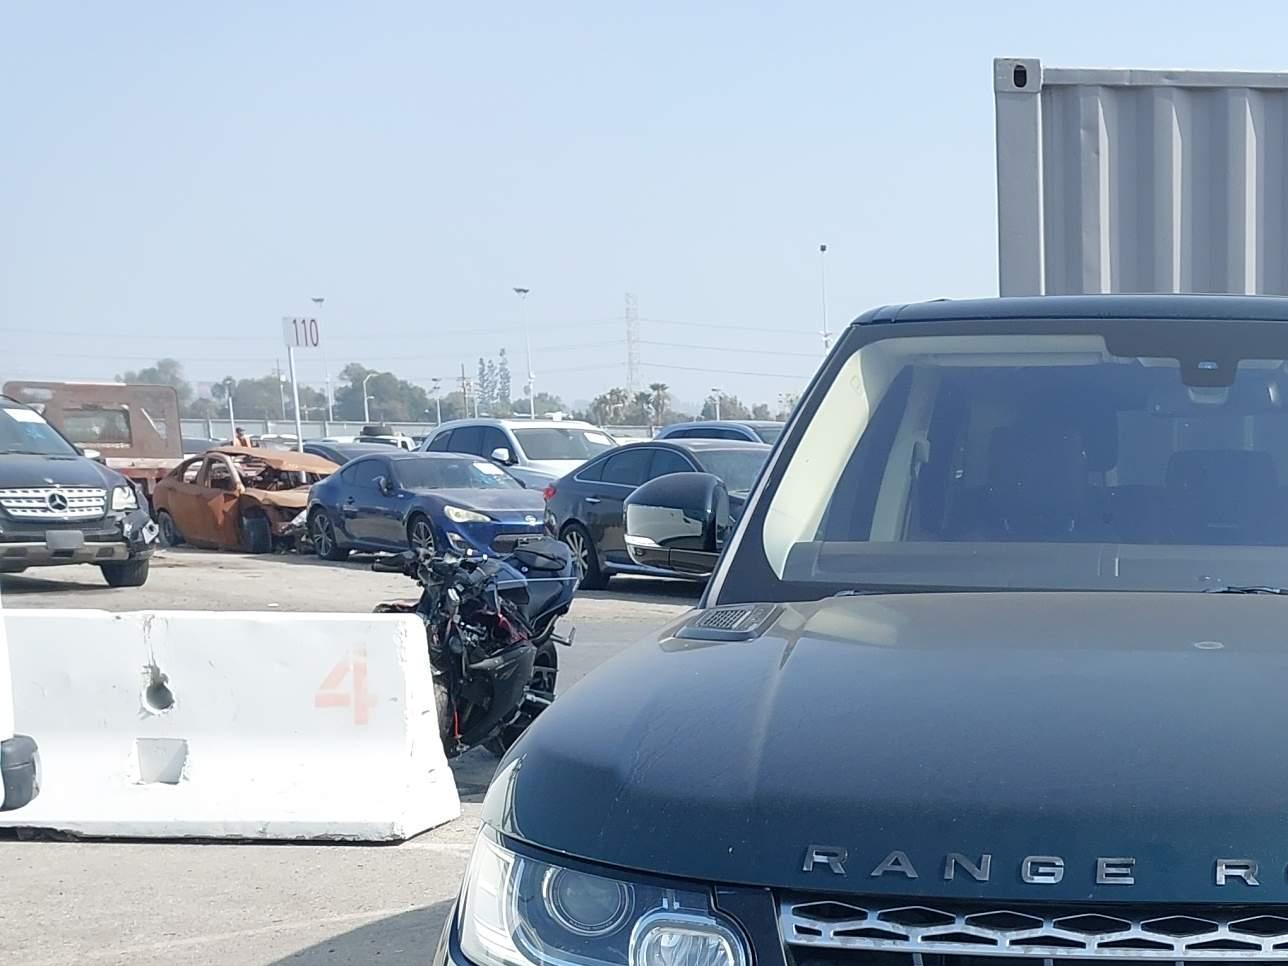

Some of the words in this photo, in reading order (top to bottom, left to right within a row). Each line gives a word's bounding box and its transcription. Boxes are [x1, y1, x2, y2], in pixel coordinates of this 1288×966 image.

[293, 318, 319, 347] 110
[314, 641, 379, 725] 4
[802, 844, 1136, 885] RANGE
